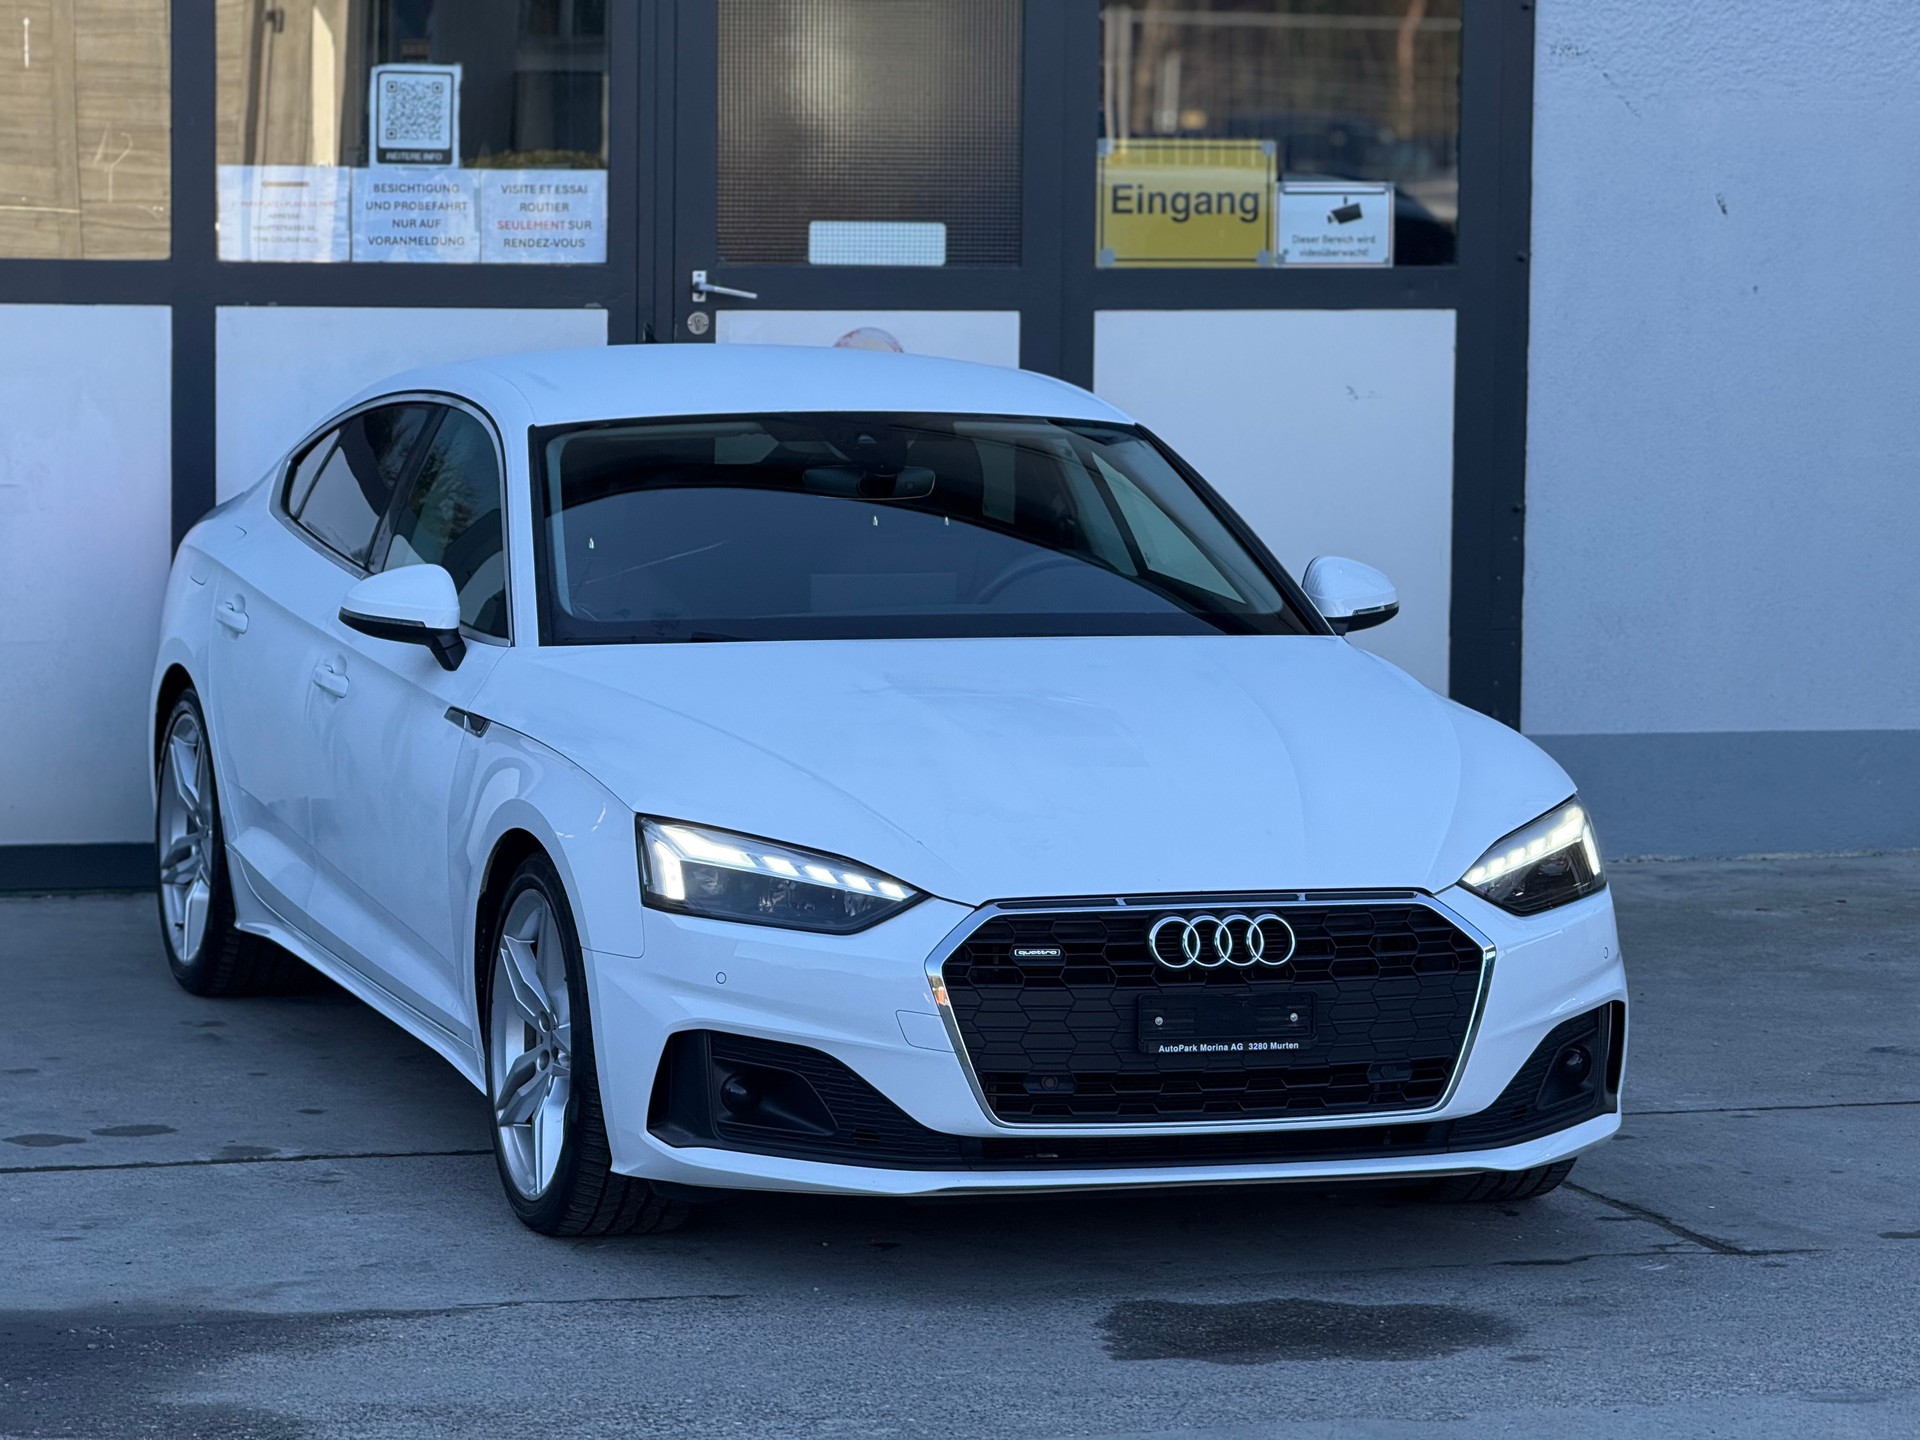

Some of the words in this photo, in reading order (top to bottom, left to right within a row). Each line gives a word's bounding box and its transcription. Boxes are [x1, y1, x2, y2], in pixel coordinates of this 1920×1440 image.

[423, 151, 443, 160] INFO
[373, 183, 460, 193] BESICHTIGUNG
[500, 184, 536, 194] VISITE
[539, 184, 552, 194] ET
[555, 184, 588, 194] ESSAI
[365, 201, 391, 211] UND
[394, 201, 468, 211] PROBEFAHRT
[519, 202, 570, 212] ROUTIER
[1111, 184, 1260, 223] Eingang
[392, 218, 417, 228] NUR
[419, 218, 442, 228] AUF
[497, 219, 566, 230] SEULEMENT
[568, 219, 592, 230] SUR
[367, 236, 465, 246] VORANMELDUNG
[503, 238, 586, 248] RENDEZ-VOUS
[1291, 234, 1319, 244] Dieser
[1322, 234, 1354, 244] Bereich
[1356, 234, 1376, 244] wird
[1158, 1044, 1198, 1053] AutoPark
[1199, 1043, 1229, 1052] Morina
[1230, 1042, 1244, 1051] AG
[1248, 1042, 1268, 1050] 3280
[1270, 1041, 1299, 1050] Murten
